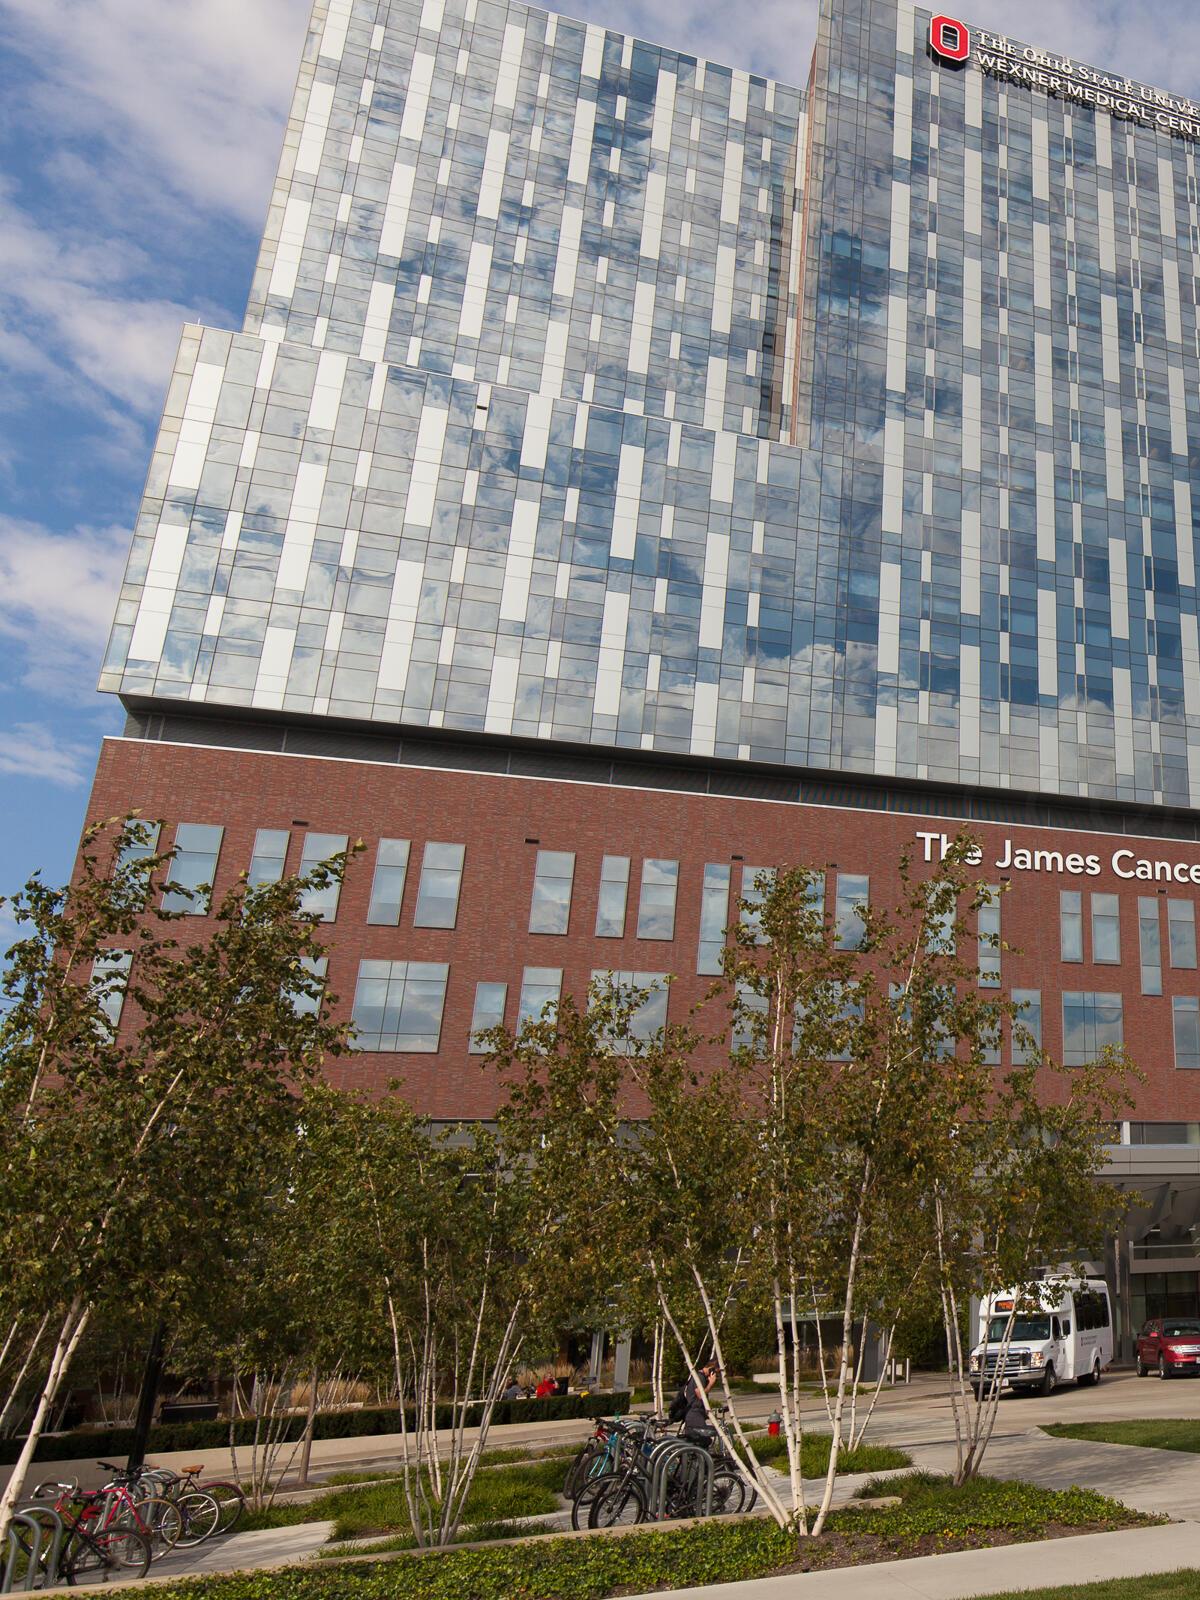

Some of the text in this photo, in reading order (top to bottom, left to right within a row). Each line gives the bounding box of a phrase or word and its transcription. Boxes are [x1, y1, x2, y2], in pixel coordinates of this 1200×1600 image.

[976, 31, 1017, 56] THE
[1023, 47, 1074, 75] OHIO
[1078, 66, 1134, 96] STATE
[977, 51, 1061, 91] WEXNER
[1067, 80, 1151, 120] MEDICAL
[995, 839, 1101, 876] James
